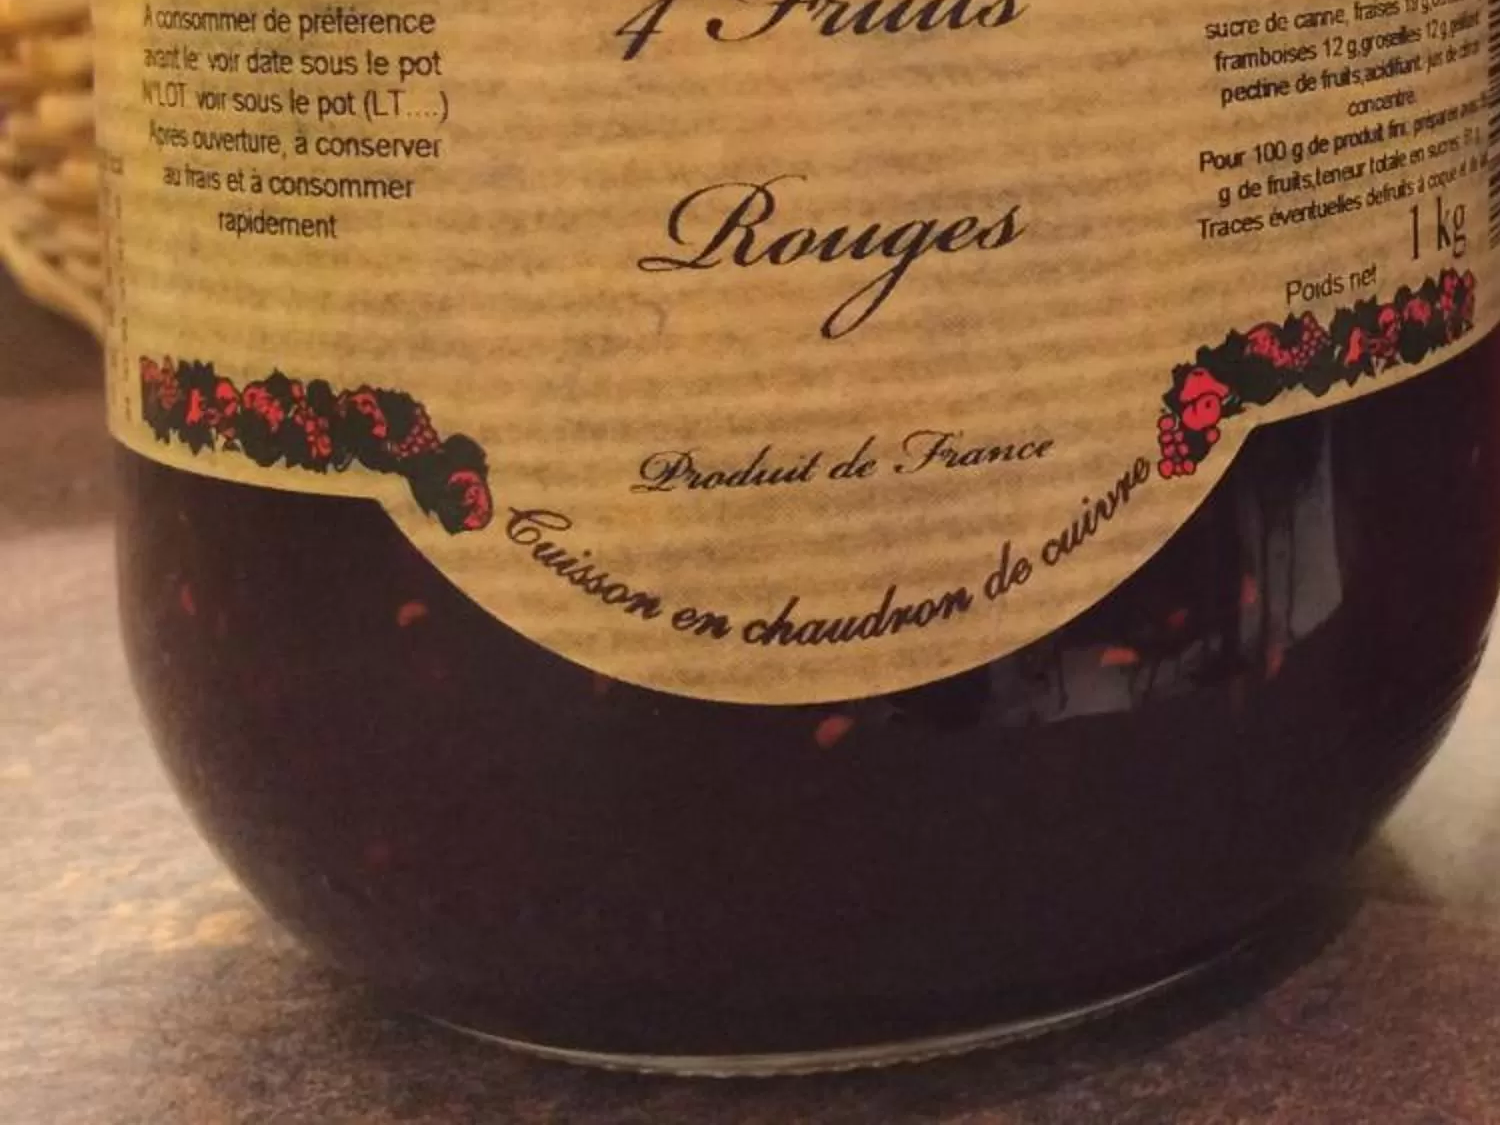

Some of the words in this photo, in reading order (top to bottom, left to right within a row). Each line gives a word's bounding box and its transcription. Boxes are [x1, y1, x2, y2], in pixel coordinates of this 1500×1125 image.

[155, 8, 256, 32] consommer
[263, 7, 291, 33] de
[299, 5, 436, 39] préférence
[1205, 13, 1260, 40] sucre
[1265, 10, 1289, 33] de
[207, 50, 239, 73] voir
[246, 49, 293, 75] date
[300, 56, 358, 76] sous
[367, 49, 388, 76] le
[399, 50, 443, 82] pot
[1215, 43, 1316, 72] framboises
[1322, 36, 1343, 58] 12
[195, 87, 227, 111] voir
[232, 92, 283, 113] sous
[289, 88, 309, 115] le
[318, 90, 356, 121] pot
[1221, 78, 1290, 107] pectine
[1295, 72, 1317, 93] de
[193, 130, 287, 160] ouverture,
[315, 135, 442, 159] conserver
[1199, 150, 1245, 173] Pour
[1254, 140, 1287, 165] 100
[1292, 142, 1304, 165] g
[1307, 134, 1330, 155] de
[227, 172, 246, 193] et
[269, 176, 415, 200] consommer
[1218, 186, 1231, 208] g
[1238, 179, 1261, 201] de
[218, 209, 339, 239] rapidement
[1198, 213, 1264, 240] Traces
[1269, 194, 1362, 227] éventuelles
[1409, 204, 1420, 261] 1
[1436, 195, 1467, 260] kg
[637, 174, 1027, 339] Rouges
[1286, 273, 1345, 306] Poids
[1350, 262, 1377, 289] net
[630, 443, 821, 493] Produit
[827, 435, 876, 482] de
[895, 429, 1054, 474] France
[505, 505, 662, 621] Cuisson
[671, 604, 731, 640] en
[742, 584, 973, 647] chaudron
[984, 540, 1033, 603] de
[1041, 455, 1152, 567] cuivre
